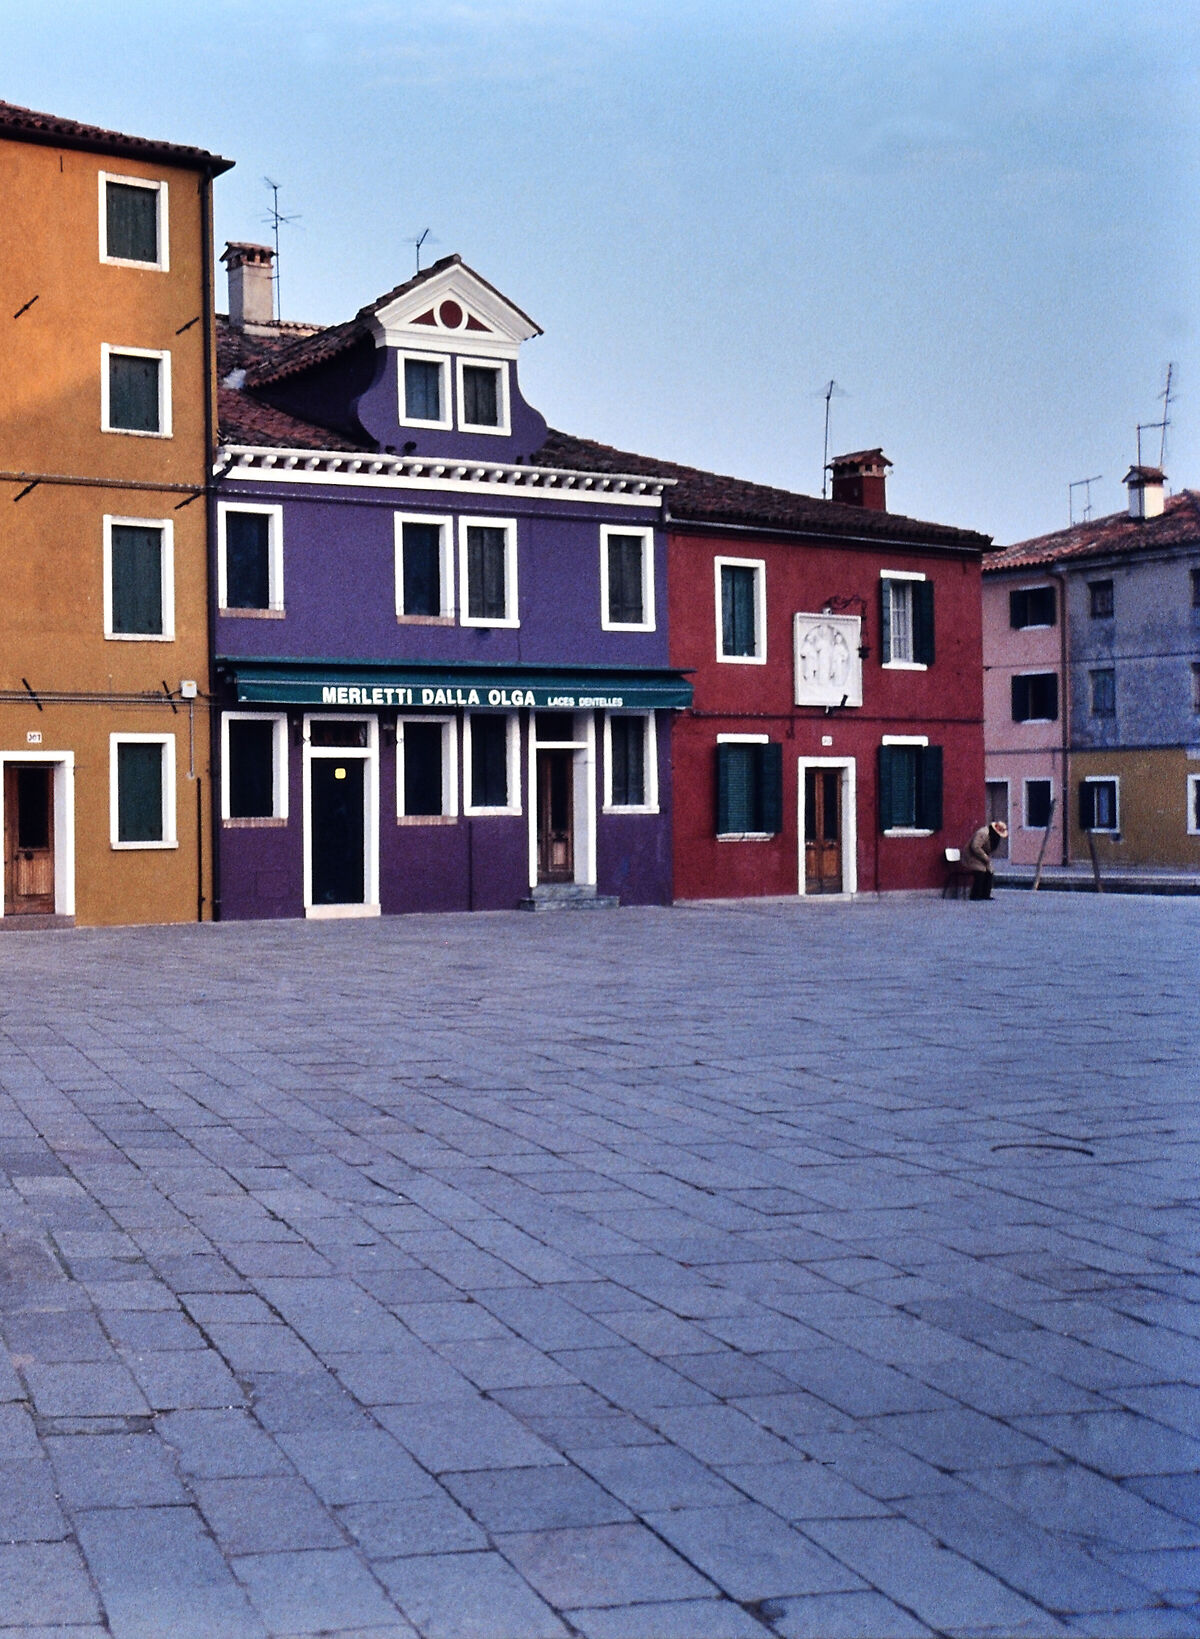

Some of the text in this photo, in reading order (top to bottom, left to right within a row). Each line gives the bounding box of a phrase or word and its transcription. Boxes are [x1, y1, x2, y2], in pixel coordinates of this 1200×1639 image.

[322, 687, 623, 707] MERLETTI DALLA OLGA LACES DENTELLES
